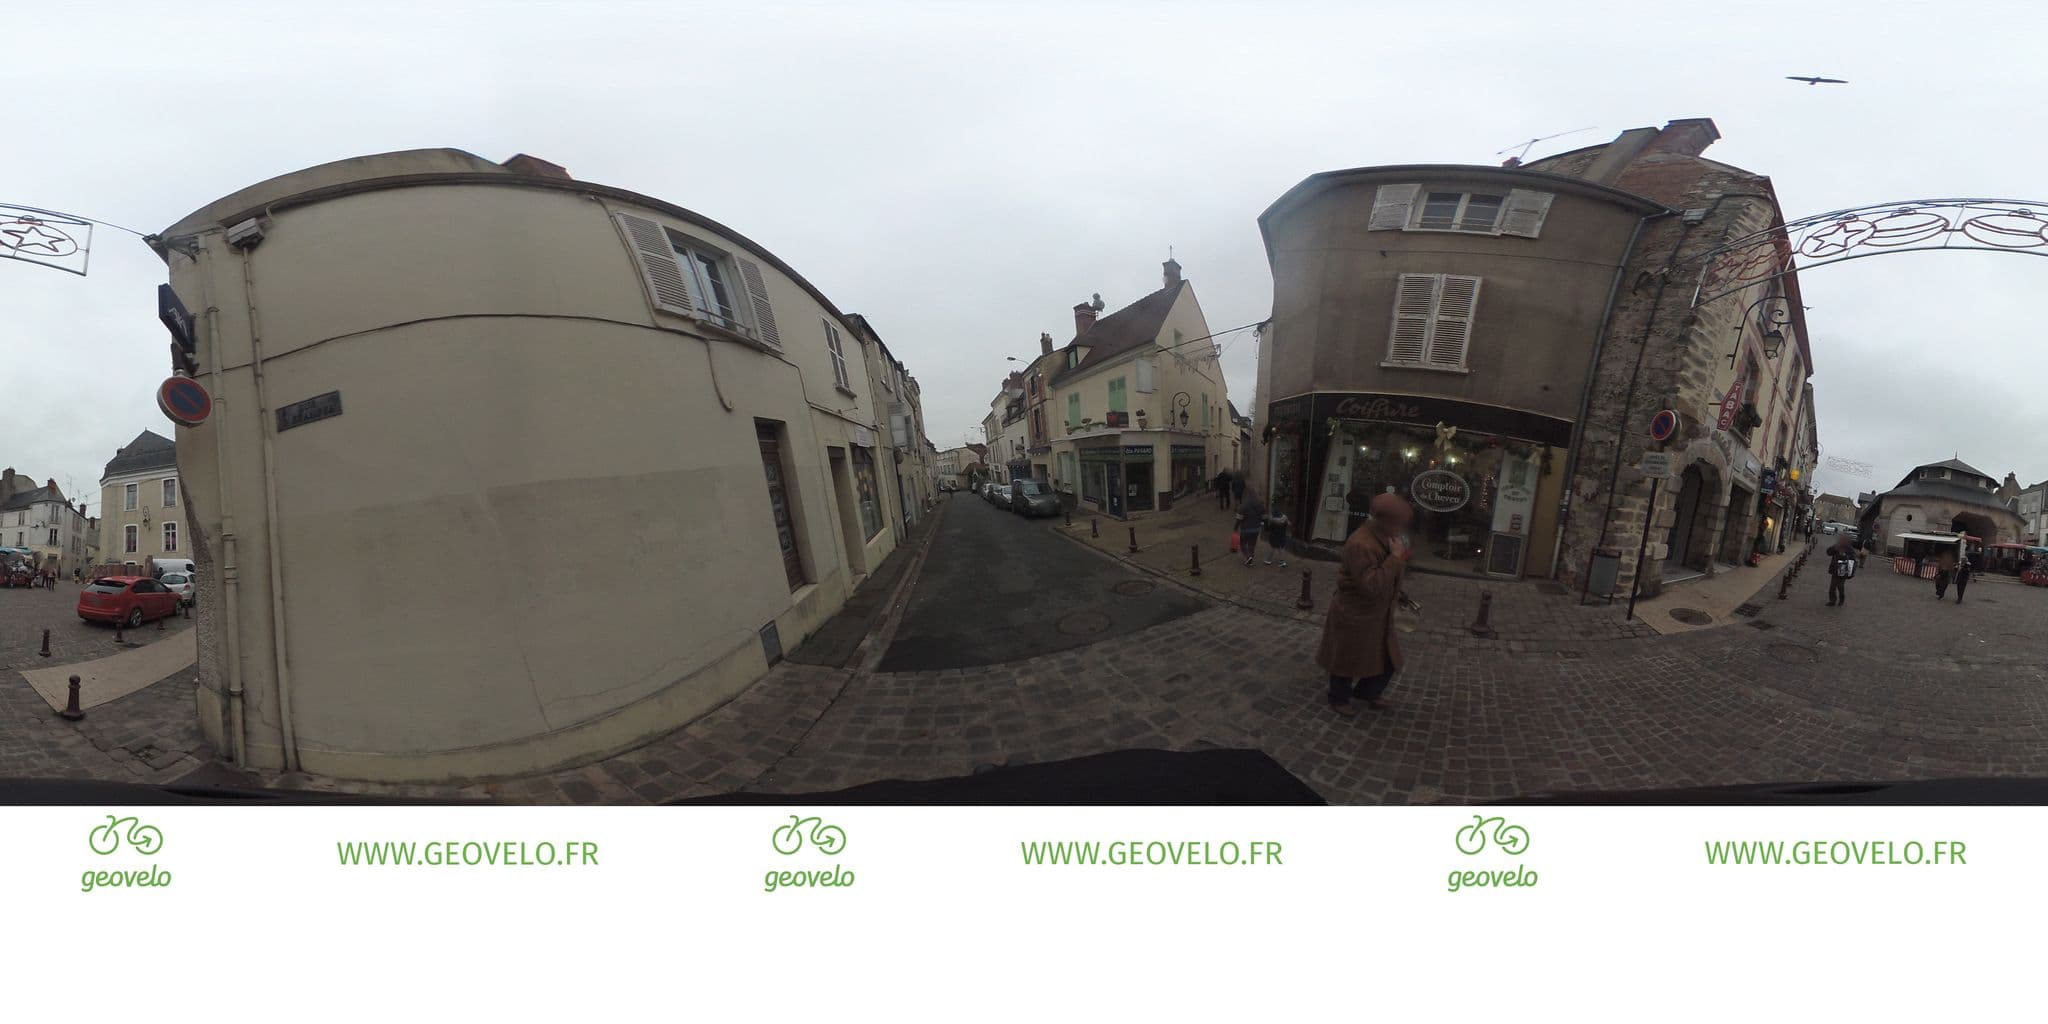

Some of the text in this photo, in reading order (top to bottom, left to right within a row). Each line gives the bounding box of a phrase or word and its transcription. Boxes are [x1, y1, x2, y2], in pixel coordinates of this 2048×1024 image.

[1335, 397, 1422, 418] Coiffure
[1720, 382, 1741, 426] TABAC
[1421, 478, 1462, 492] Comptoir
